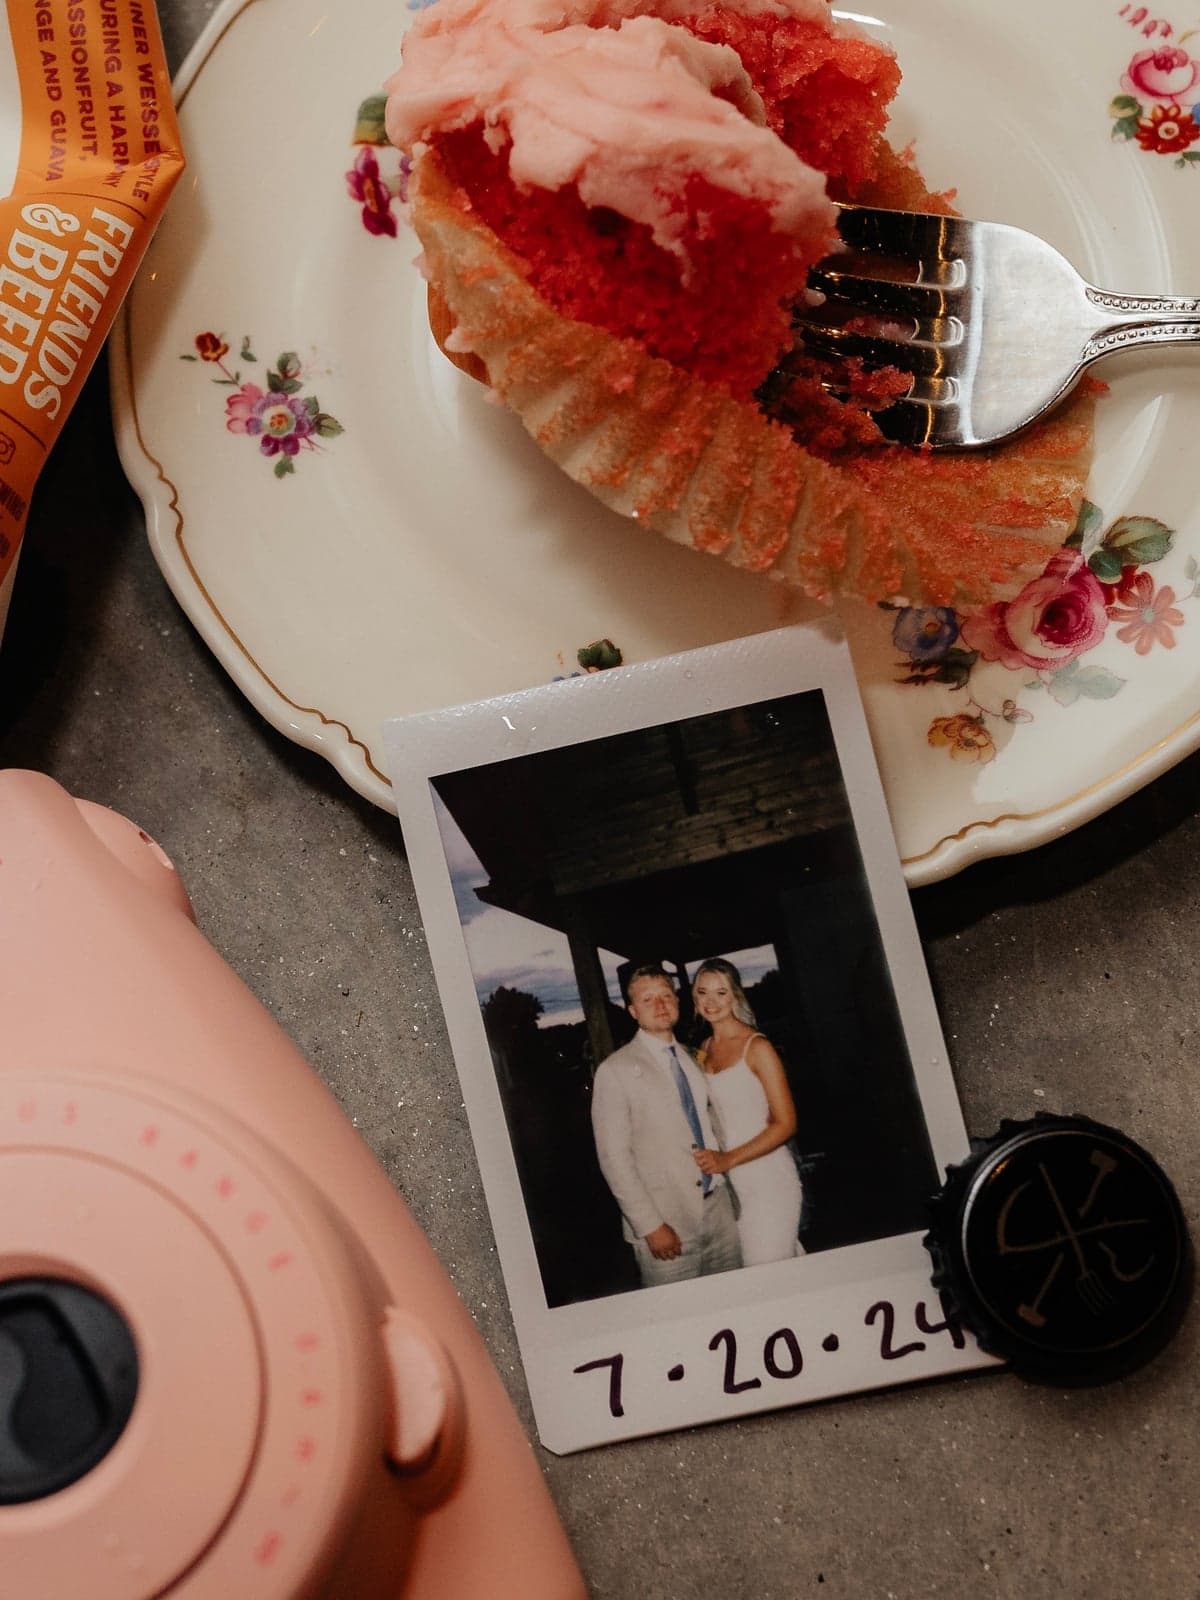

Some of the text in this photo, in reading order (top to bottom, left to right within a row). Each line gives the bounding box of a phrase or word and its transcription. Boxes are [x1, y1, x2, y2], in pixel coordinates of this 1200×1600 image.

[40, 50, 63, 102] AND
[106, 81, 123, 98] A
[137, 63, 161, 154] WEISSE
[45, 109, 67, 182] GUAVA
[23, 207, 135, 422] FRIENDS
